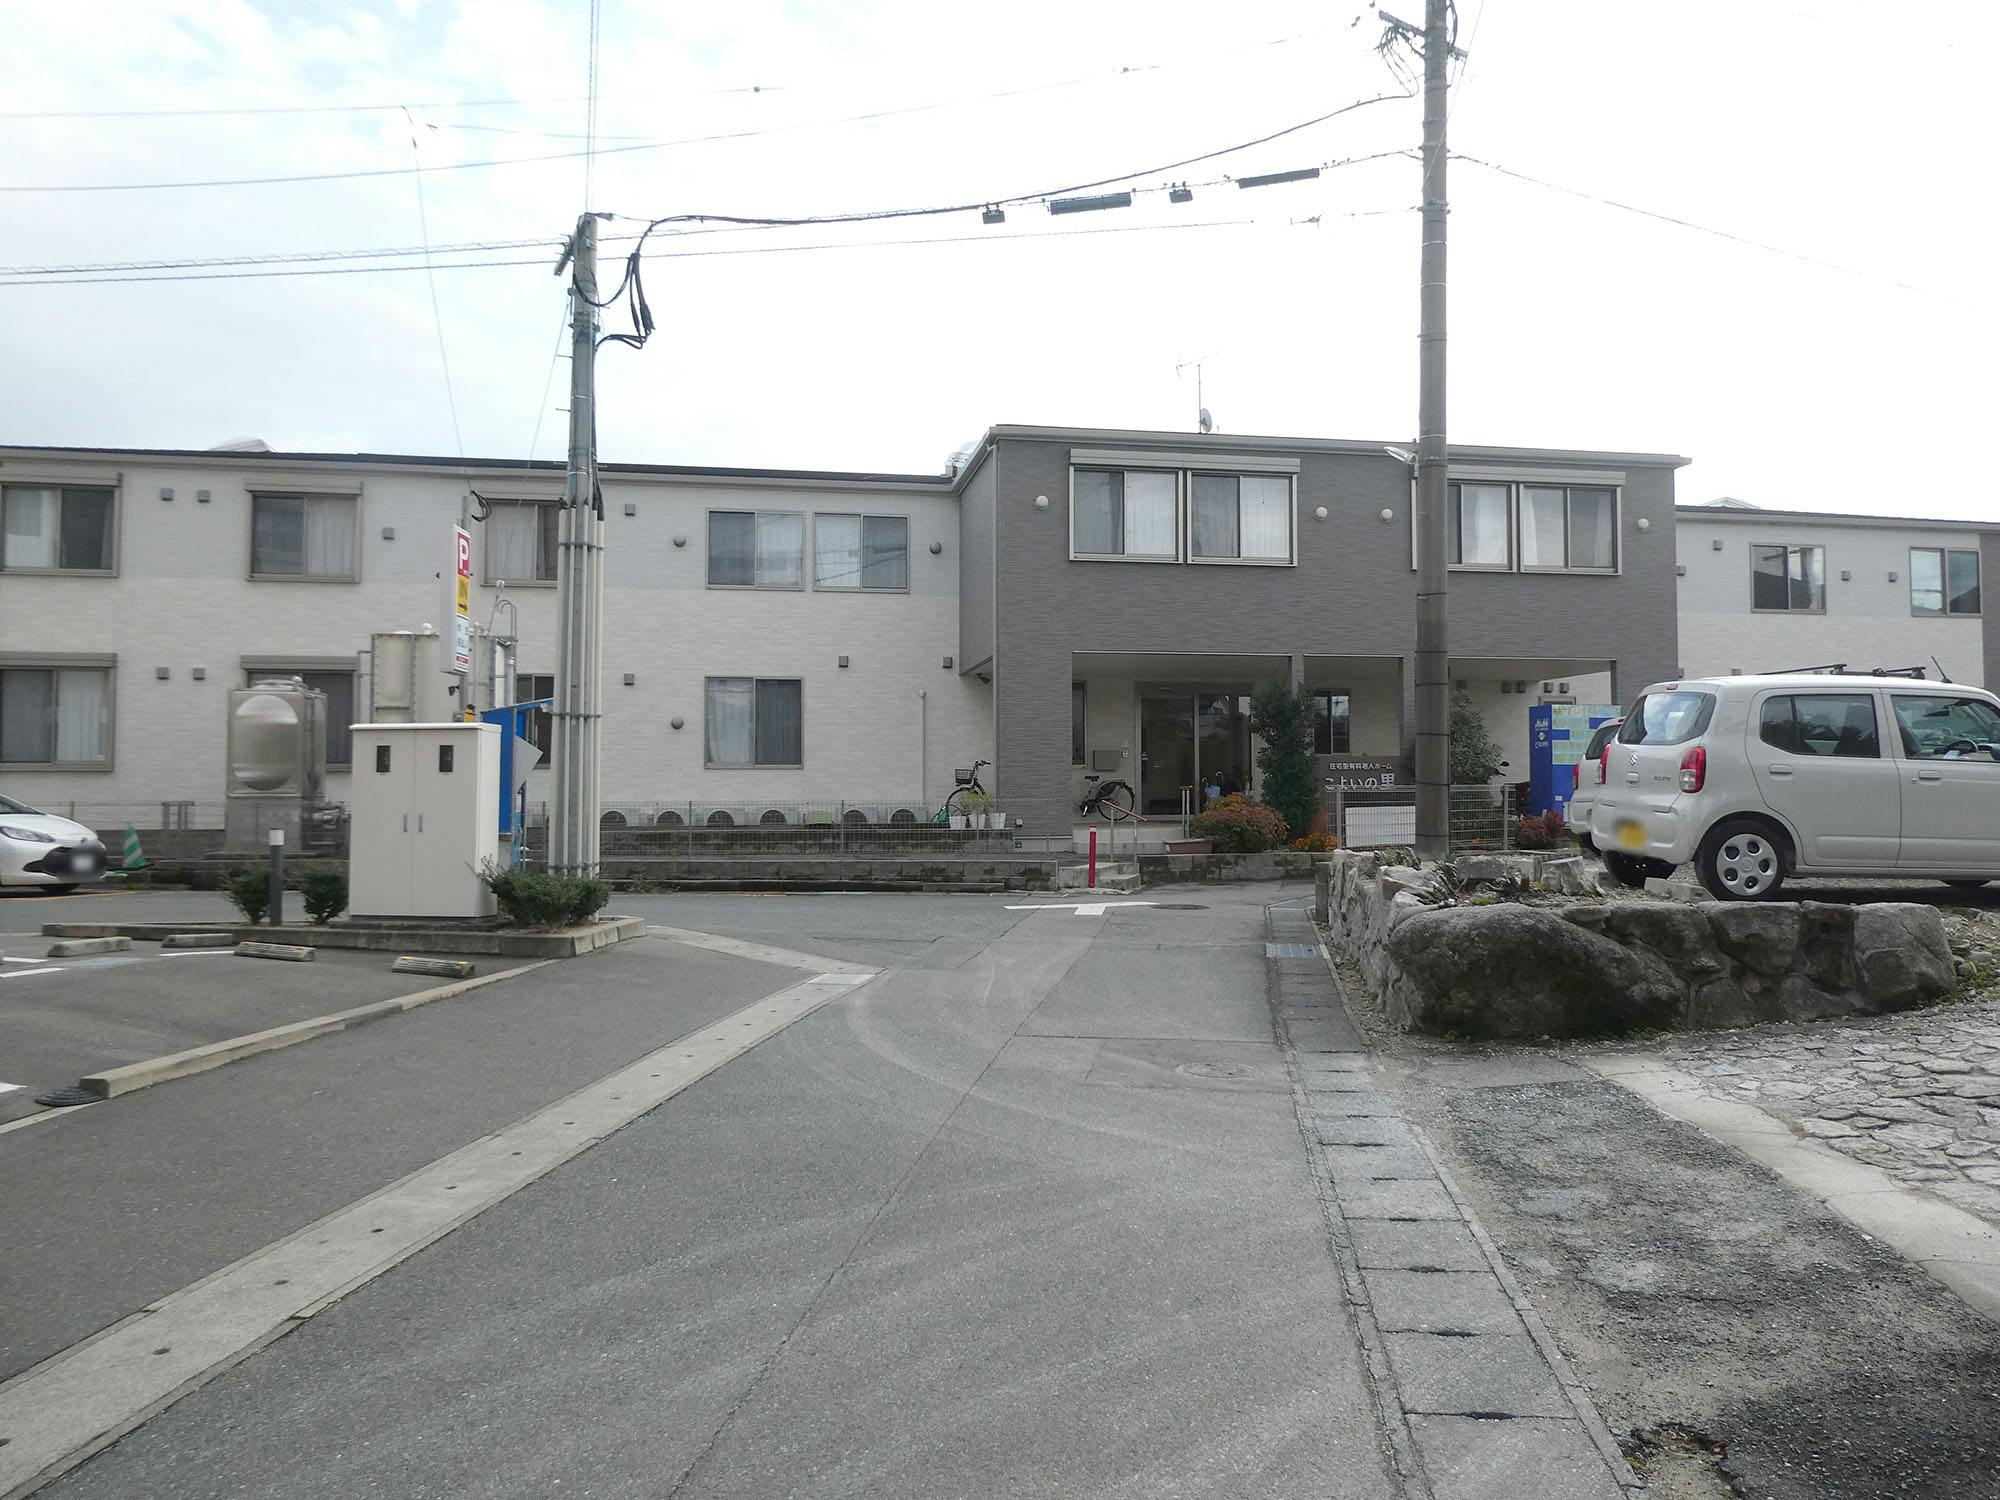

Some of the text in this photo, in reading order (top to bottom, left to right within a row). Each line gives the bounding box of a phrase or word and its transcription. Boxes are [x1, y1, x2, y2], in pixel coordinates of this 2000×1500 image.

[459, 537, 469, 570] P
[1324, 773, 1395, 791] こよいの里
